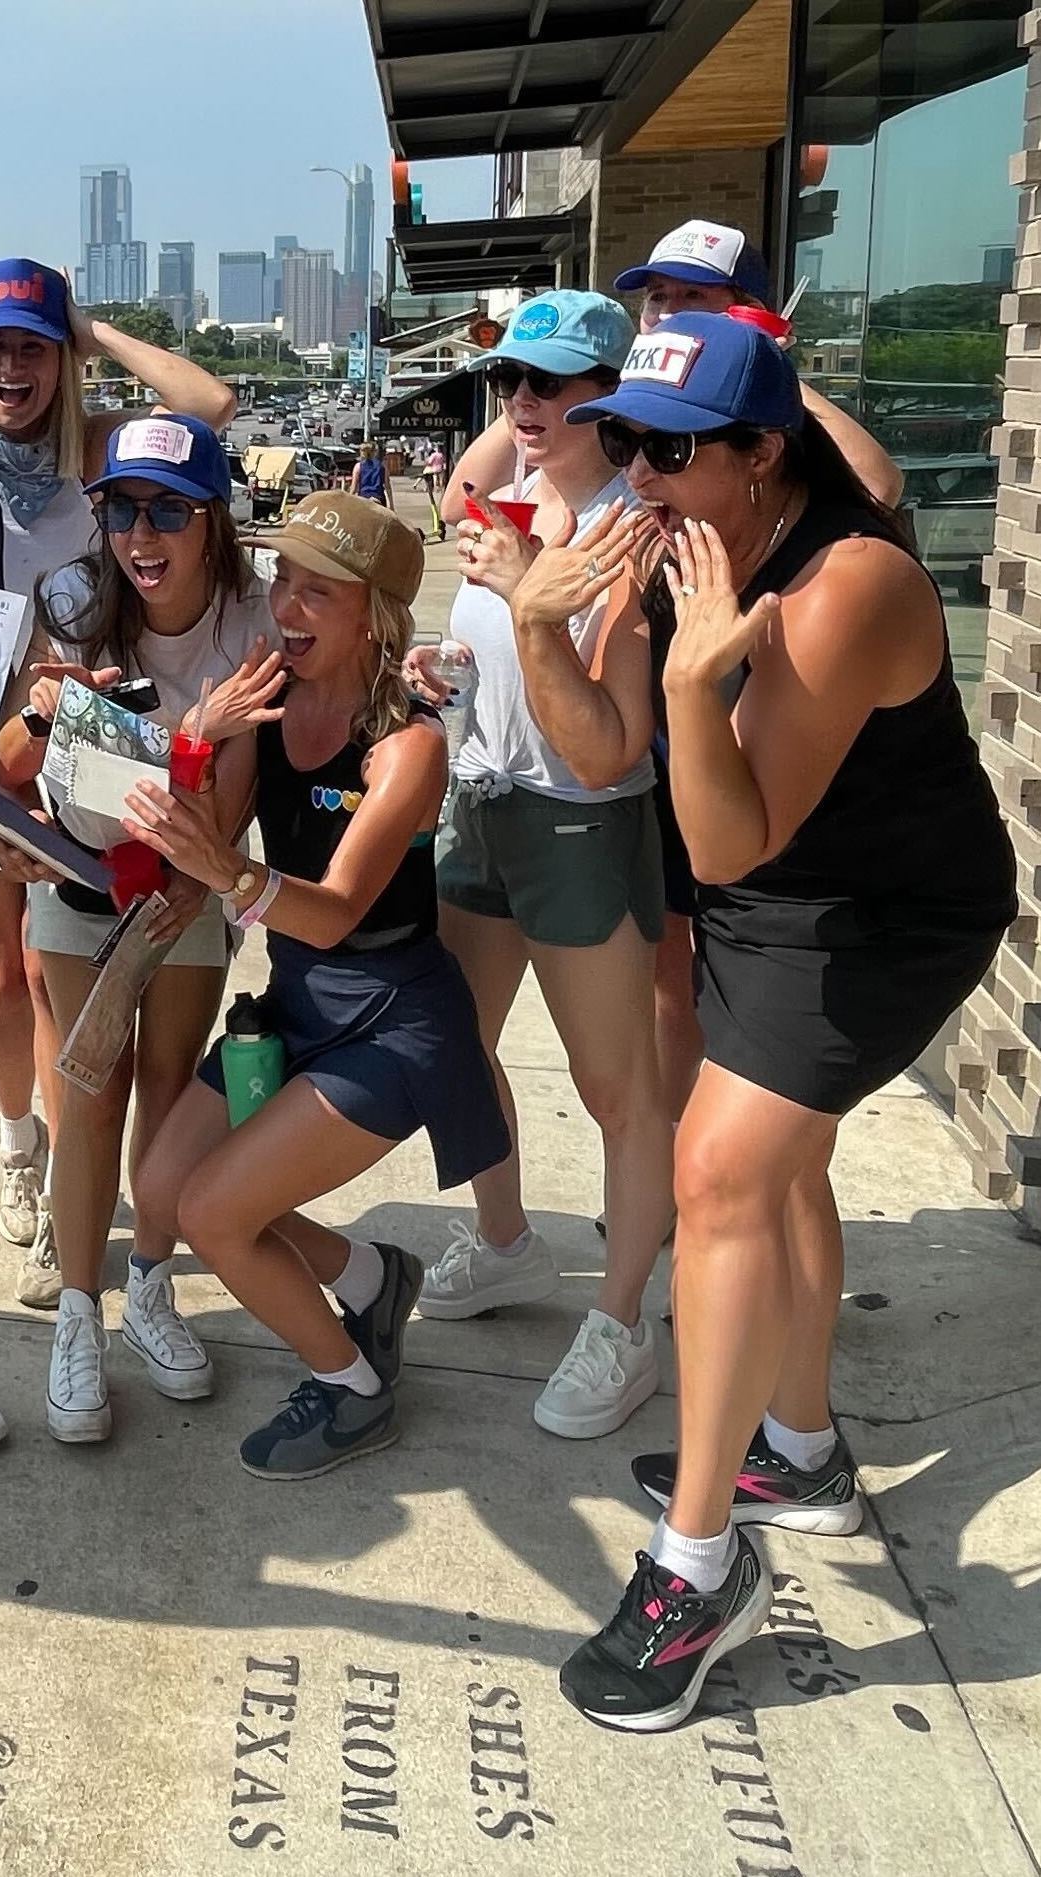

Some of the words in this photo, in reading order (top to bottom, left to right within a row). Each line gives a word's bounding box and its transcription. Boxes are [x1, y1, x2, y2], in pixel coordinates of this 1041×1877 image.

[390, 416, 420, 427] HAT
[228, 1655, 300, 1851] TEXAS
[341, 1664, 400, 1841] FROM
[467, 1672, 556, 1841] SHE'S
